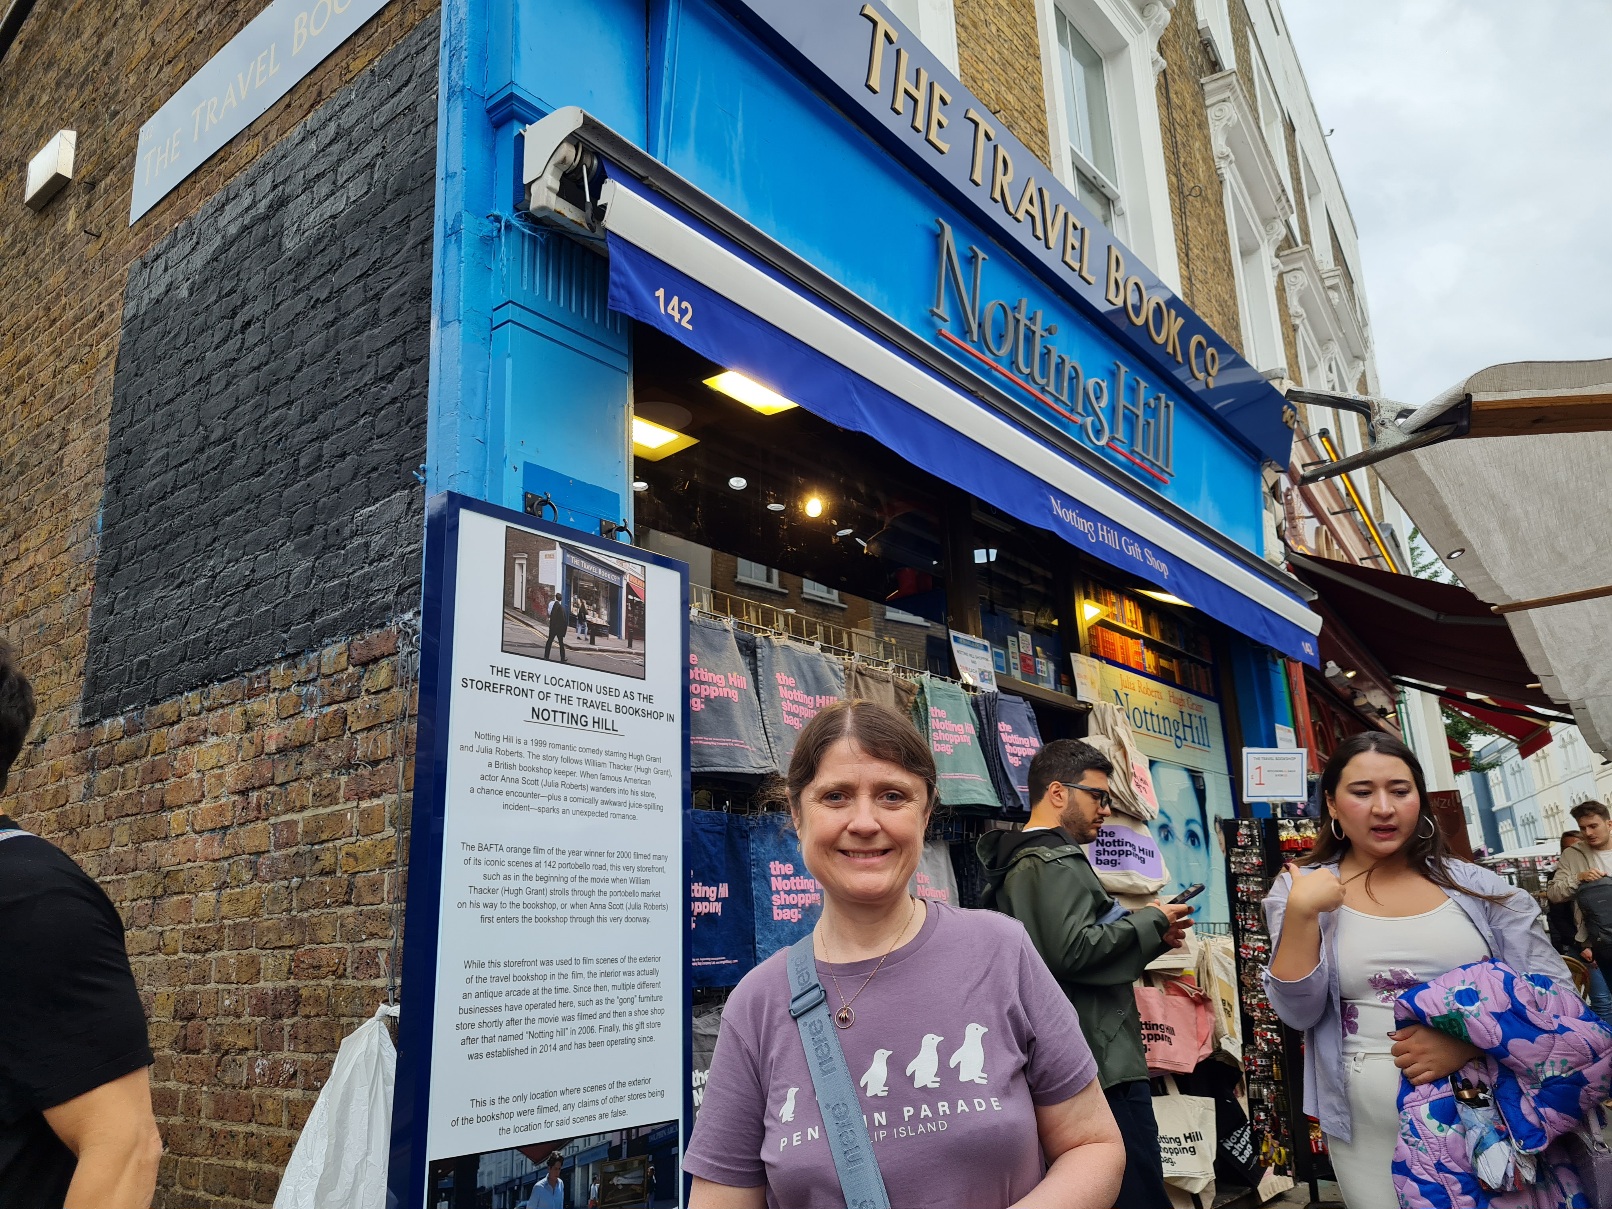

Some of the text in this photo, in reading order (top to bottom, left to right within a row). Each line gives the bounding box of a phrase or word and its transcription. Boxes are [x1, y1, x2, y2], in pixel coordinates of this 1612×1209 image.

[143, 128, 182, 187] THE
[191, 42, 280, 143] TRAVEL
[859, 4, 952, 155] THE
[964, 108, 1096, 285] TRAVEL
[1105, 244, 1185, 364] BOOK
[655, 288, 692, 331] 142
[929, 217, 1175, 477] Notting Hill
[1049, 495, 1169, 579] Notting Hill Gift Shop
[490, 665, 655, 705] THE VERY LOCATION USED AS THE
[728, 672, 747, 690] Hill
[775, 672, 796, 687] the
[1120, 674, 1136, 691] Julia
[1137, 679, 1163, 700] Roberts
[461, 677, 675, 723] STOREFRONT OF THE TRAVEL BOOKSHOP IN
[778, 686, 814, 709] Notting
[531, 706, 619, 732] NOTTING HILL
[930, 706, 947, 718] the
[931, 719, 965, 735] Notting
[932, 730, 972, 746] shopping
[998, 721, 1013, 733] the
[474, 731, 500, 743] Notting
[503, 735, 514, 744] Hill
[516, 736, 522, 745] is
[530, 739, 547, 748] 1999
[549, 742, 577, 752] romantic
[578, 746, 603, 757] comedy
[604, 749, 627, 760] starring
[629, 752, 645, 762] Hugh
[645, 754, 662, 764] Grant
[459, 744, 673, 778] and Julia Roberts. The story follows William Thacker (Hugh Grant),
[494, 760, 517, 771] British
[519, 763, 553, 776] bookshop
[554, 767, 578, 778] keeper.
[580, 770, 599, 780] When
[600, 773, 622, 783] famous
[624, 776, 652, 786] American
[1097, 829, 1116, 838] the
[1095, 838, 1154, 858] Notting Hill
[1095, 848, 1146, 865] shopping
[769, 861, 794, 875] the
[771, 876, 815, 893] Notting
[470, 1077, 652, 1108] This is the only location where scenes of the exterior
[450, 1089, 665, 1127] of the bookshop were filmed, any claims of other stores being
[498, 1109, 629, 1136] the location for said scenes are false.
[780, 1098, 1002, 1151] PENIN PARADE
[893, 1120, 948, 1139] ISLAND
[1157, 1131, 1203, 1147] otting Hill
